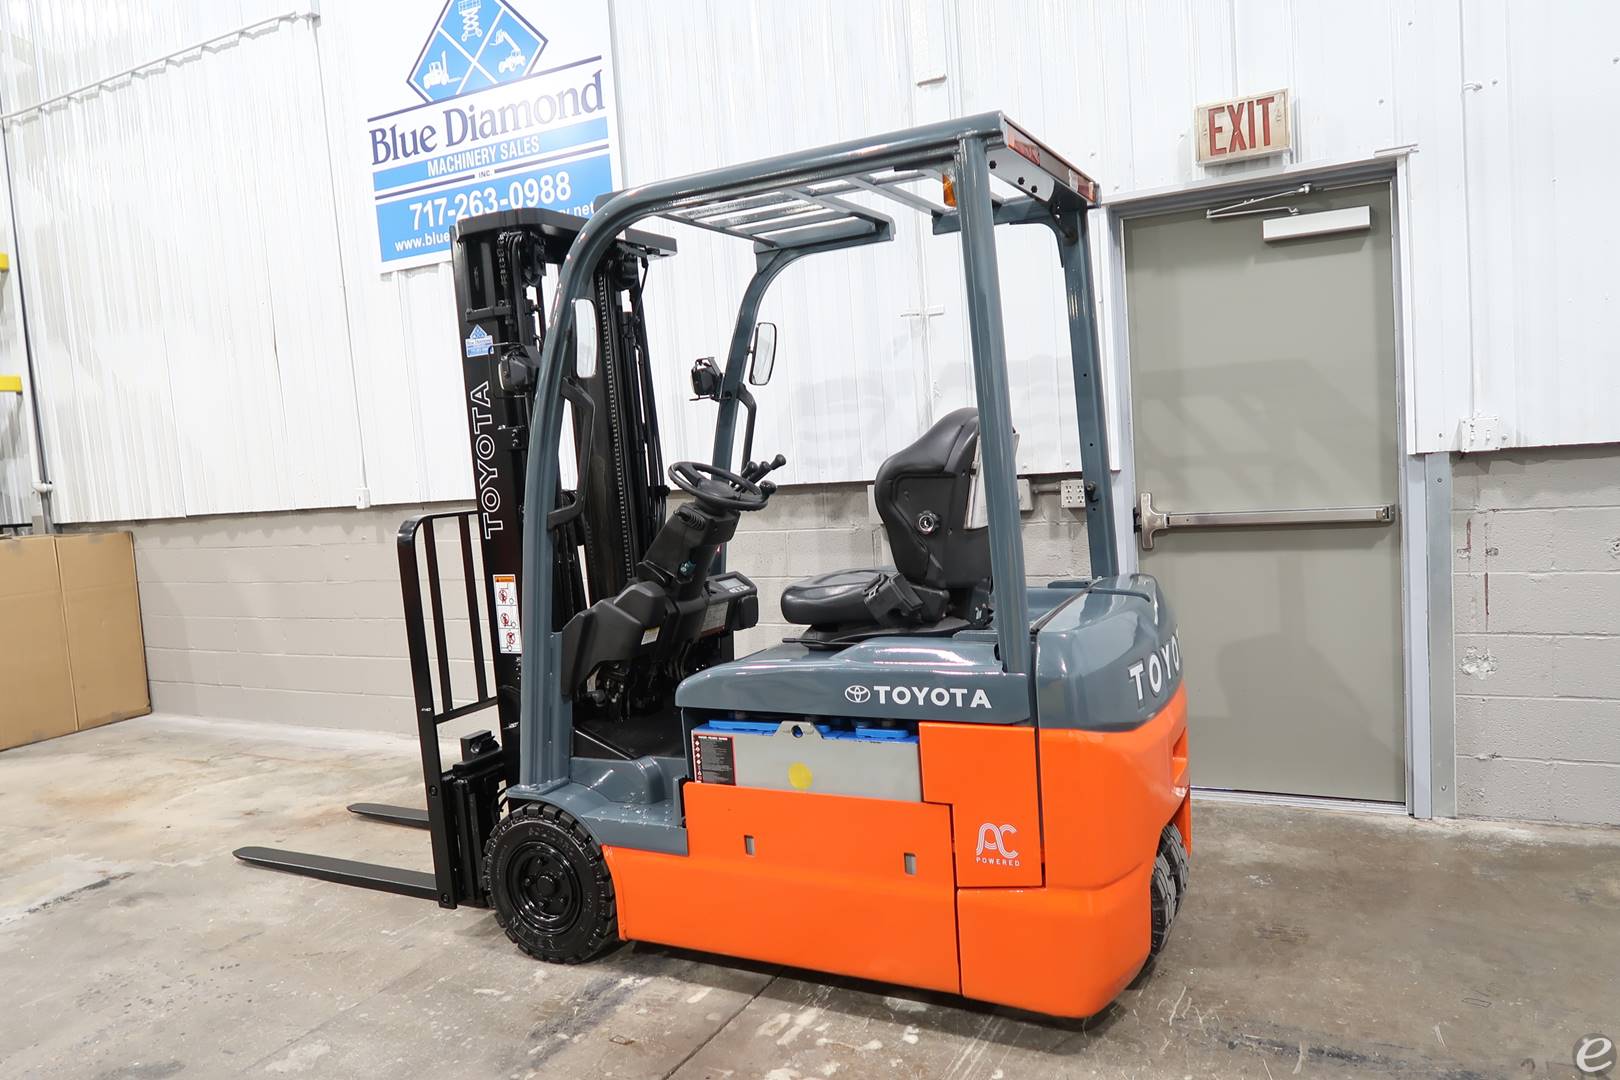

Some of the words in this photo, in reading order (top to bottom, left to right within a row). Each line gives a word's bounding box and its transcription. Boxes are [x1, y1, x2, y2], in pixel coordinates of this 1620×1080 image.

[369, 124, 437, 166] Blue
[443, 69, 605, 147] Diamond
[1208, 96, 1275, 156] EXIT
[427, 146, 497, 177] MACHINERY
[500, 135, 540, 161] SALES
[478, 170, 493, 179] INC.
[409, 171, 571, 231] 717-263-0988
[394, 231, 450, 252] www.blue
[470, 380, 504, 540] TOYOTA
[873, 685, 992, 709] TOYOTA
[976, 822, 1019, 859] AC
[975, 857, 1020, 867] POWERED
